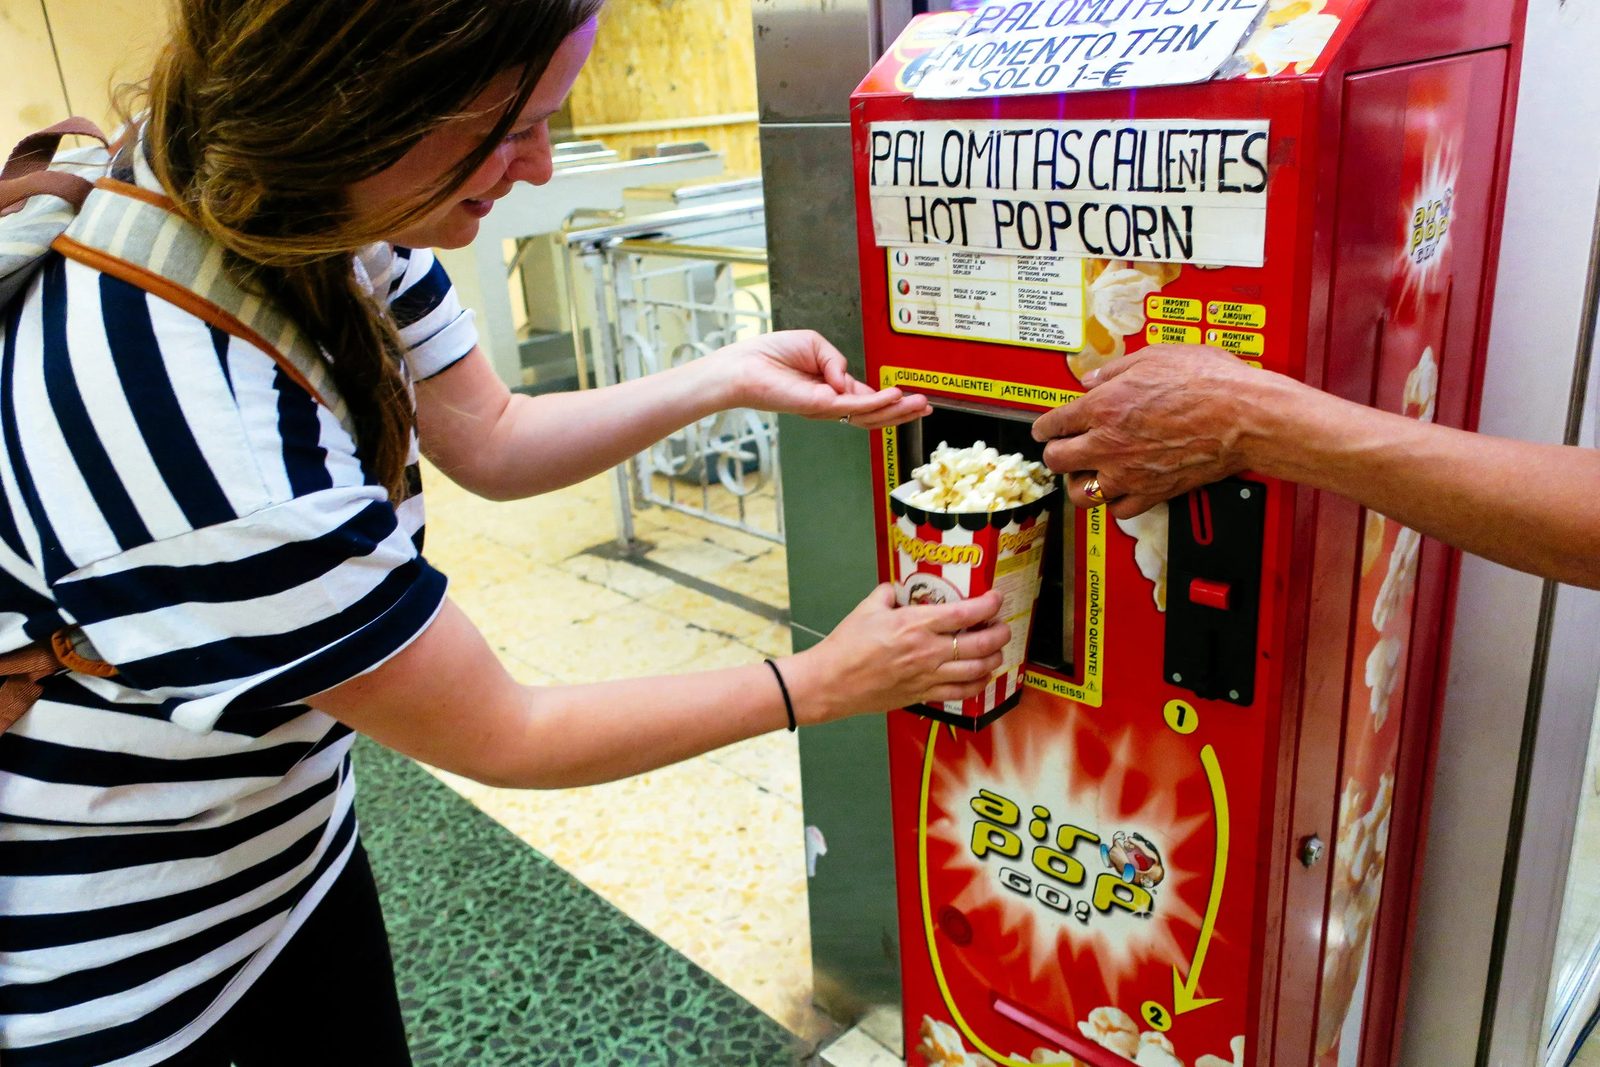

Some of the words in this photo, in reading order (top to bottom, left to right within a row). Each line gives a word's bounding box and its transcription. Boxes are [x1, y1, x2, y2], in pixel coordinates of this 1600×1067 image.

[939, 31, 1117, 71] MOMENTO
[1120, 20, 1219, 58] TAN
[968, 65, 1060, 92] SOLO
[870, 128, 1082, 190] PALOMITAS
[1088, 128, 1269, 194] CALIENTES
[905, 195, 976, 246] HOT
[994, 199, 1194, 261] POPCORN
[1163, 299, 1190, 307] IMPORTE
[1223, 312, 1251, 321] AMOUNT
[1162, 326, 1186, 334] GENAUE
[1162, 334, 1184, 342] SUMME
[1223, 332, 1254, 342] MONTANT
[1060, 393, 1080, 403] HO
[1092, 508, 1100, 535] AUD!
[1088, 627, 1098, 676] QUENTE!
[1026, 674, 1048, 688] UNG
[1052, 682, 1085, 700] HEISS!
[1176, 705, 1187, 728] 1
[1150, 1006, 1164, 1026] 2
